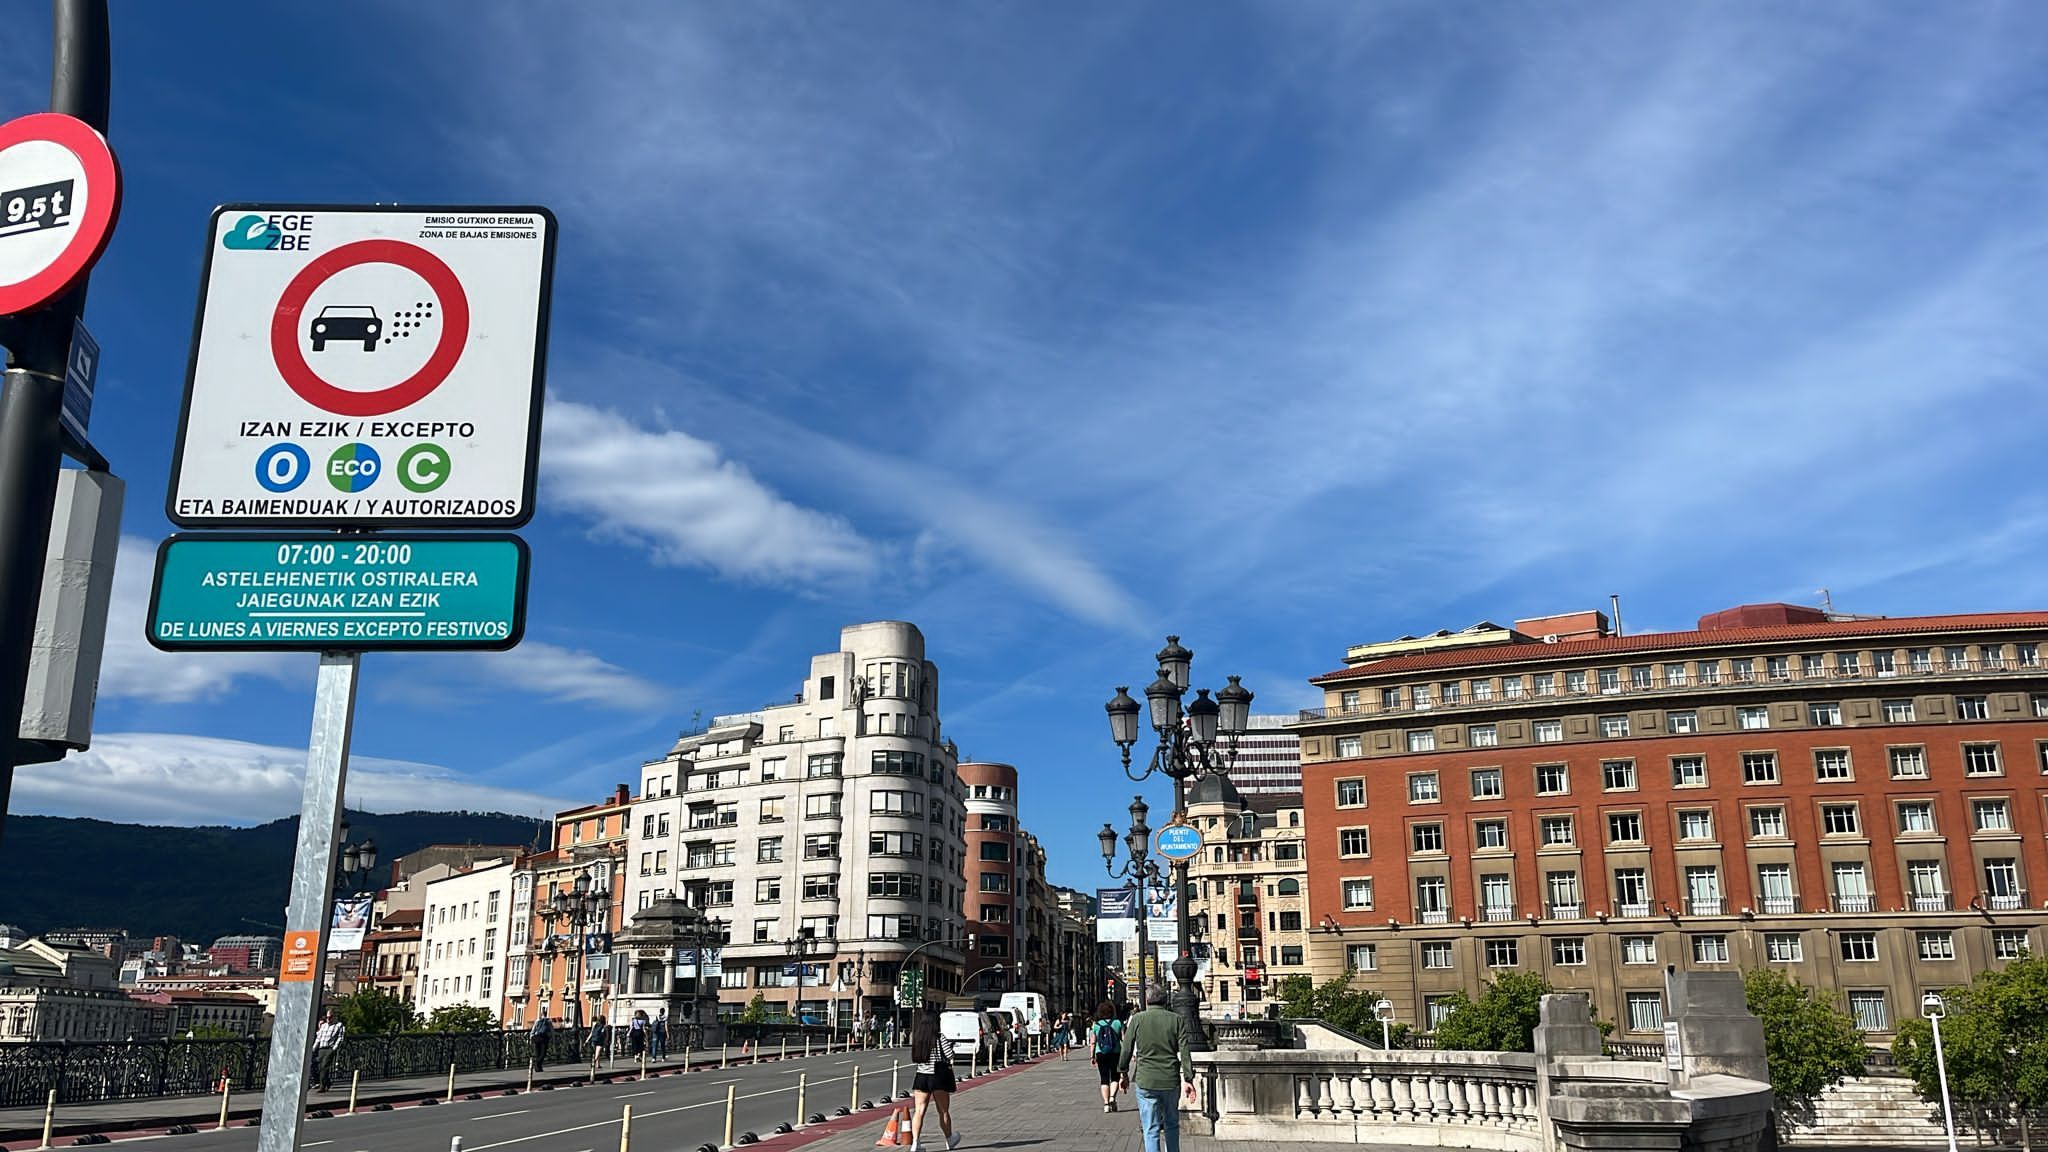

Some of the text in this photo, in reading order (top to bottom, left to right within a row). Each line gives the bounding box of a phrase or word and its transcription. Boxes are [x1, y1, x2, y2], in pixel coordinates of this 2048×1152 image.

[7, 190, 64, 222] 9,5 t
[268, 215, 314, 230] EGE
[265, 235, 310, 250] ZBE
[240, 422, 291, 437] IZAN
[300, 422, 350, 437] EZIK
[371, 422, 474, 437] EXCEPTO
[331, 460, 376, 476] ECO
[408, 451, 441, 485] C
[179, 500, 214, 514] ETA
[222, 500, 348, 514] BAIMENDUAK
[366, 500, 379, 514] Y
[381, 500, 516, 515] AUTORIZADOS
[277, 544, 335, 565] 07:00
[354, 544, 412, 565] 20:00
[202, 572, 479, 587] ASTELEHENETIK OSTIRALERA
[236, 593, 440, 608] JAIEGUNAK IZAN EZIK
[160, 621, 508, 637] DE LUNES A VIERNES EXCEPTO FESTIVOS
